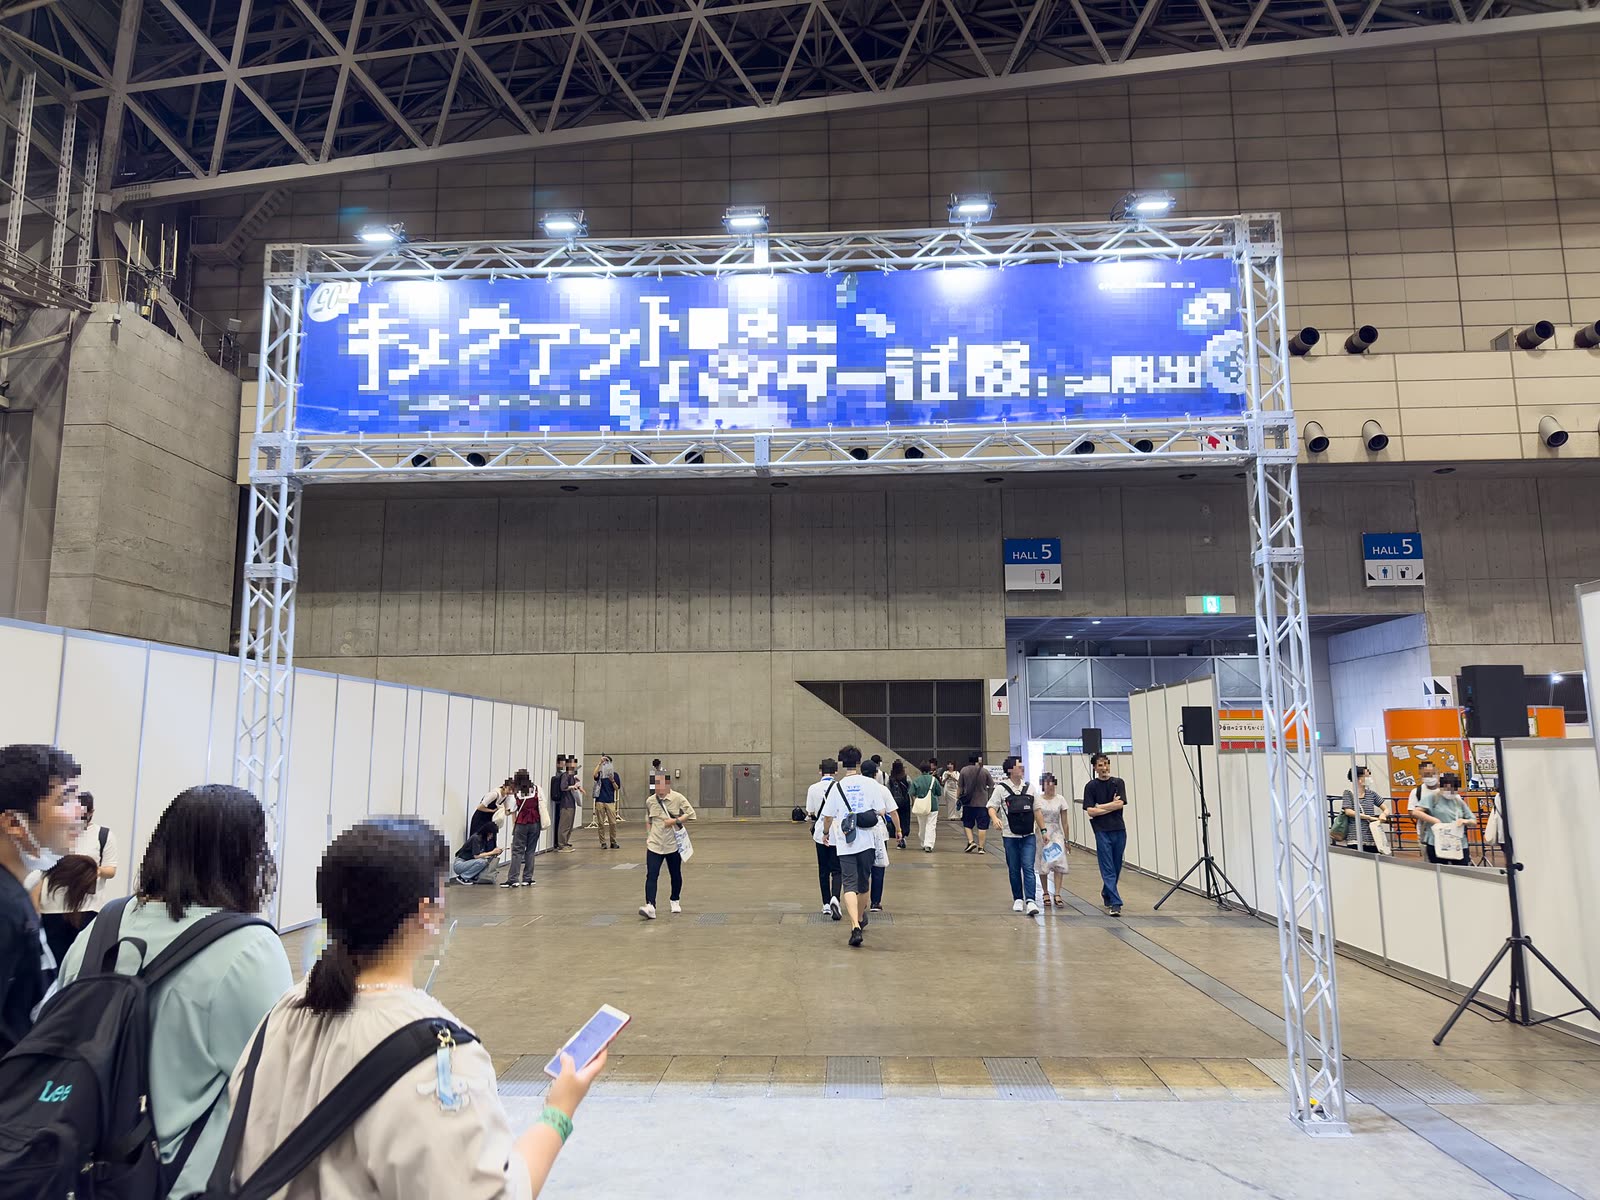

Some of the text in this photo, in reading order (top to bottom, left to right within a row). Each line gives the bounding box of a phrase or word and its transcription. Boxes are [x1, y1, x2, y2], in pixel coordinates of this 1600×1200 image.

[1012, 543, 1053, 560] HALL 5
[1372, 538, 1414, 555] HALL 5
[38, 1080, 73, 1103] Lee
